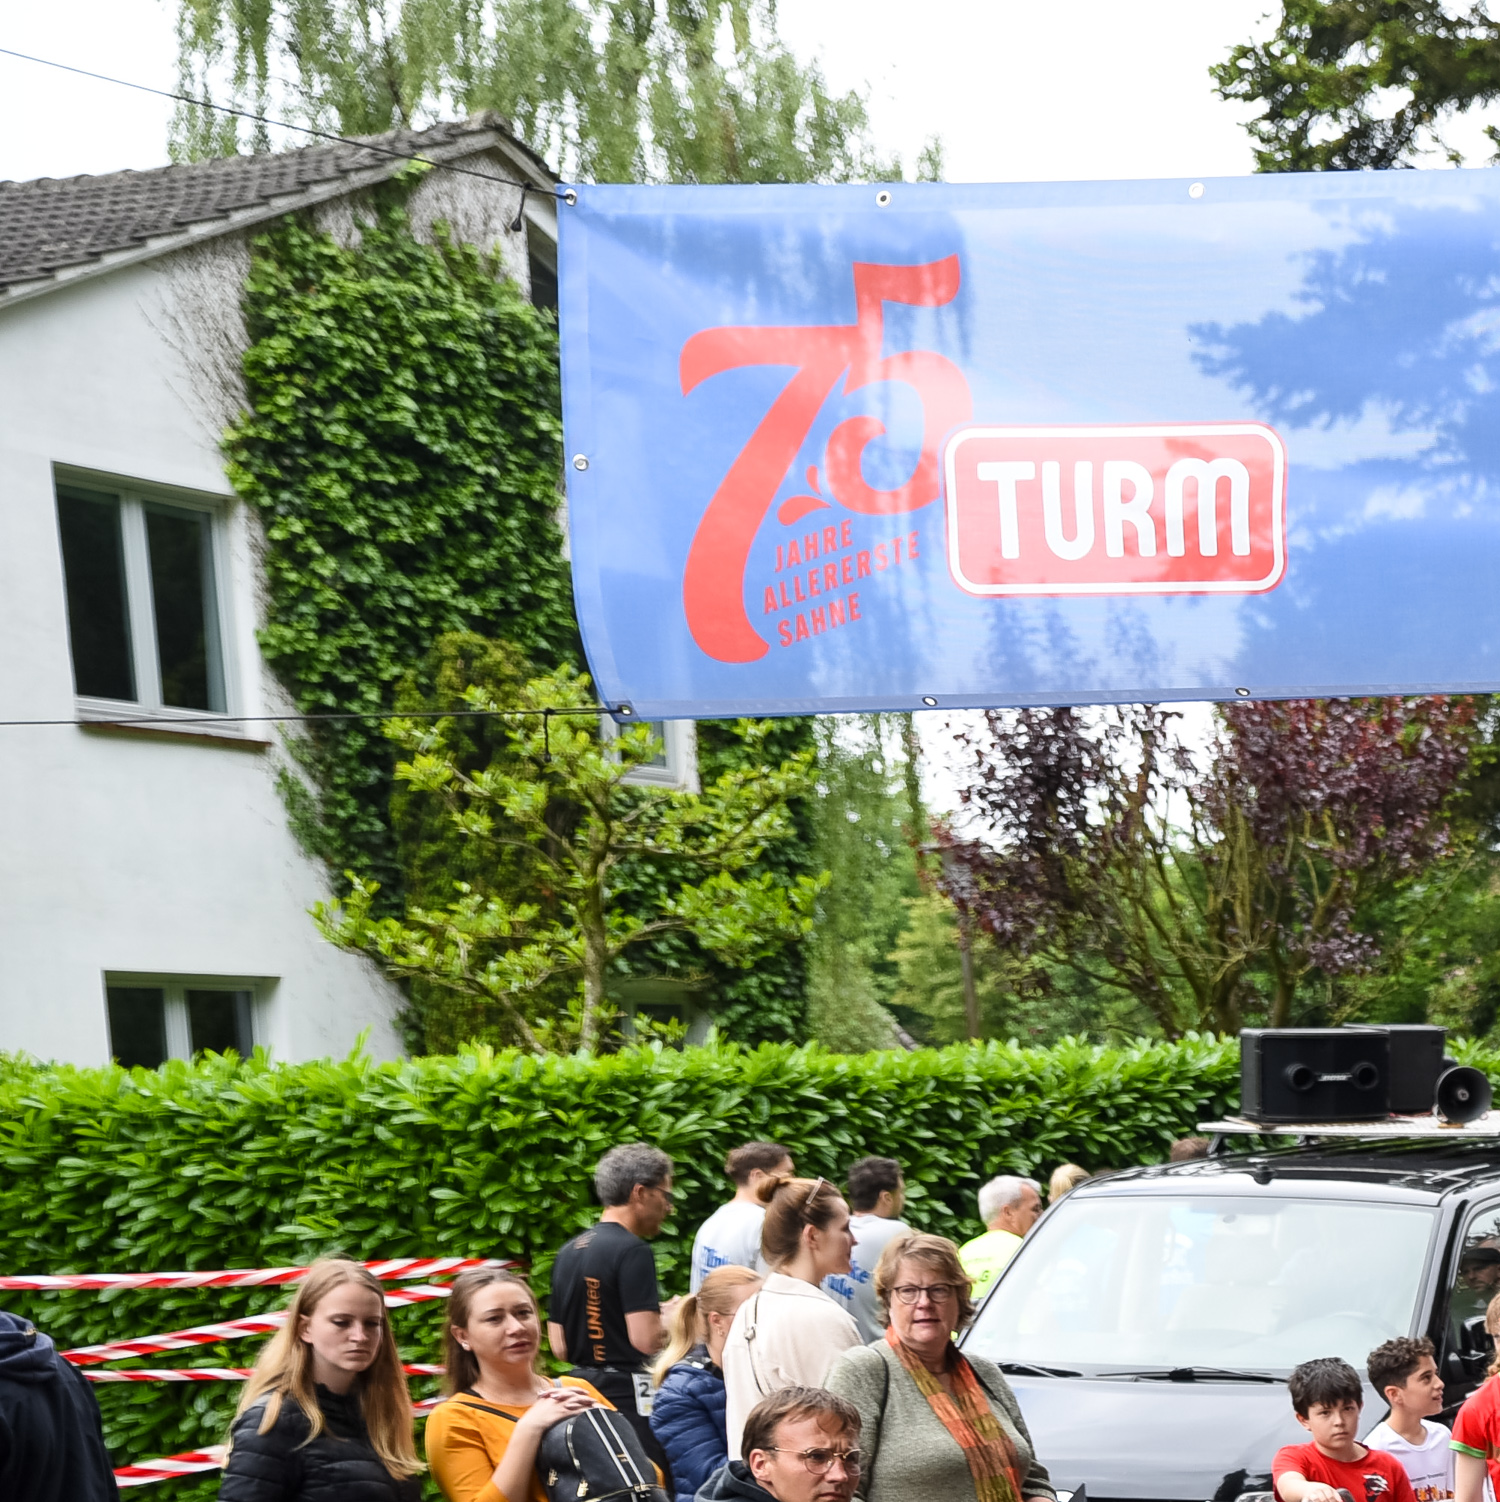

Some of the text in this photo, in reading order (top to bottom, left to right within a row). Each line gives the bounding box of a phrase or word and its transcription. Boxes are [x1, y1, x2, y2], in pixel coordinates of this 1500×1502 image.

[679, 253, 974, 665] 75
[774, 518, 854, 574] JAHRE
[975, 457, 1251, 562] TURM
[763, 530, 921, 616] ALLERERSTE
[777, 592, 863, 649] SAHNE
